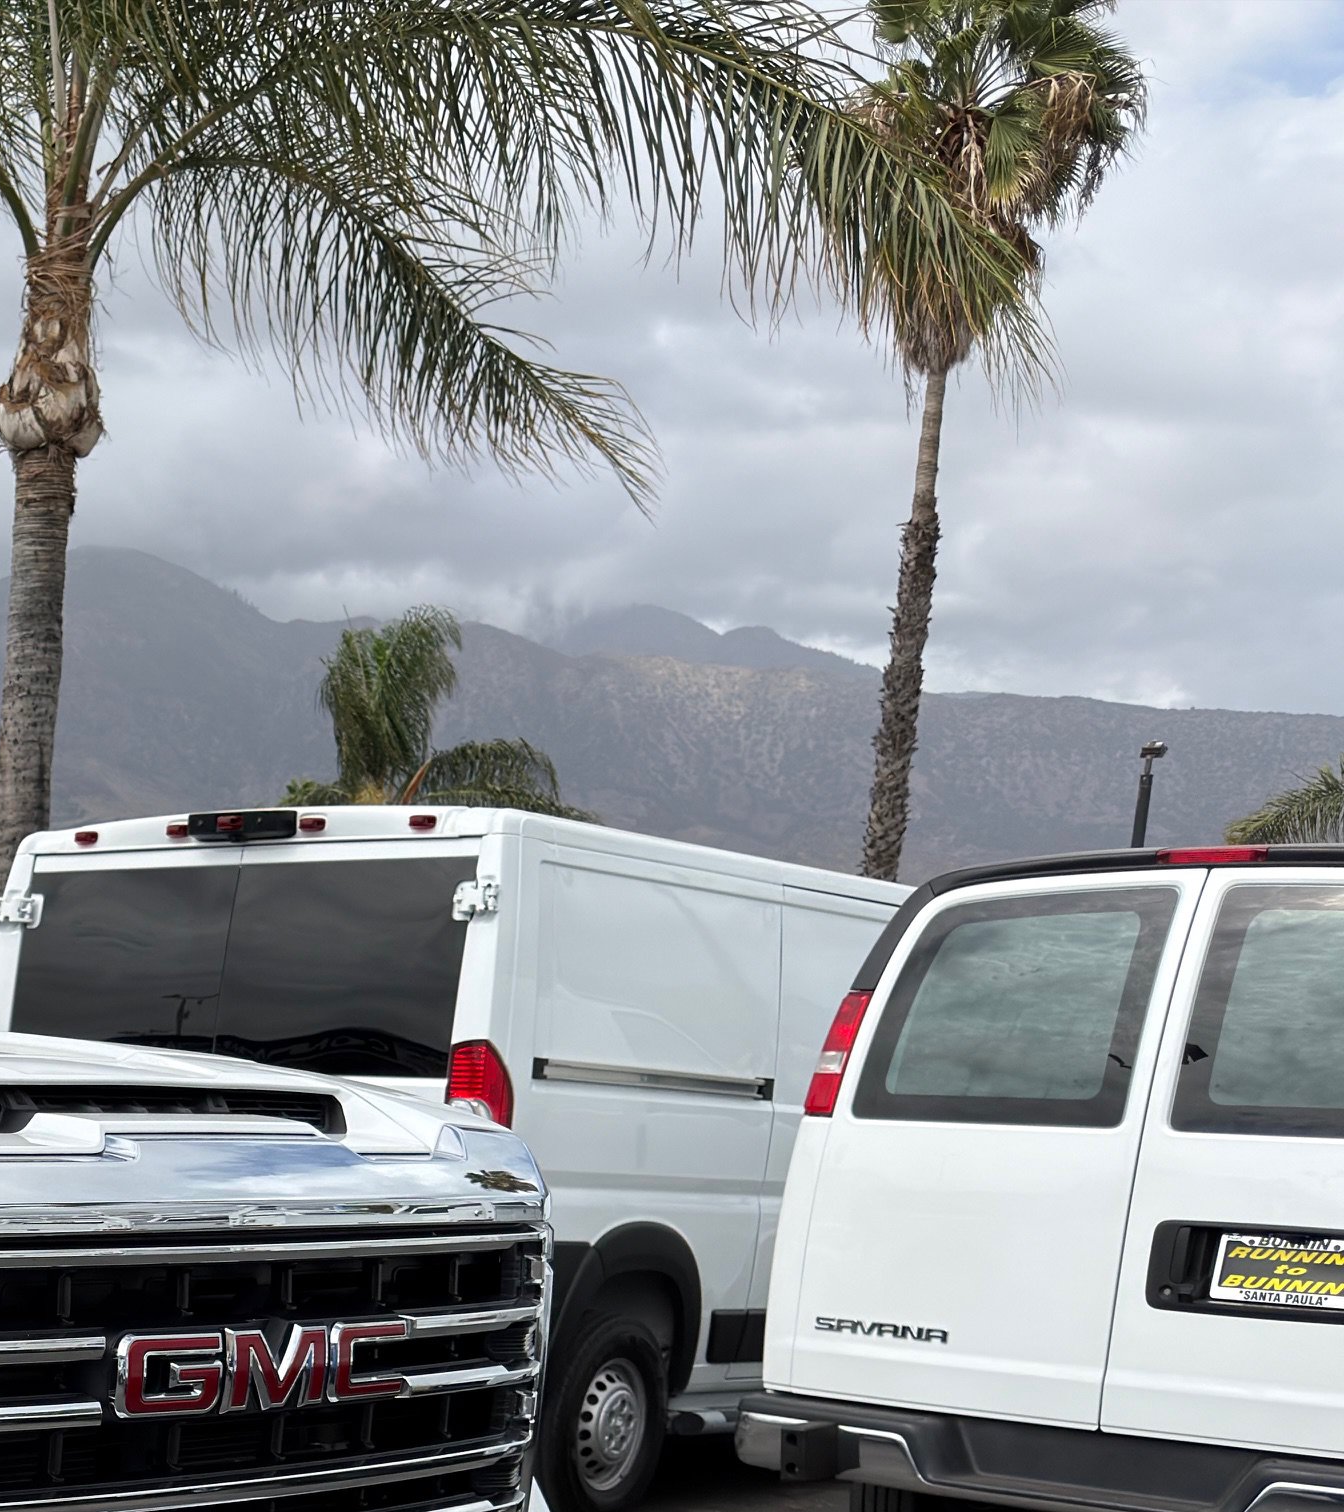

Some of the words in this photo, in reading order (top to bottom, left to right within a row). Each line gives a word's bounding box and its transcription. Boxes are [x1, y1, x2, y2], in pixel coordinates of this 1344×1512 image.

[1273, 1264, 1308, 1276] to
[1221, 1274, 1344, 1296] BUNNIN
[814, 1316, 949, 1344] SAVANA
[112, 1321, 409, 1418] GMC
